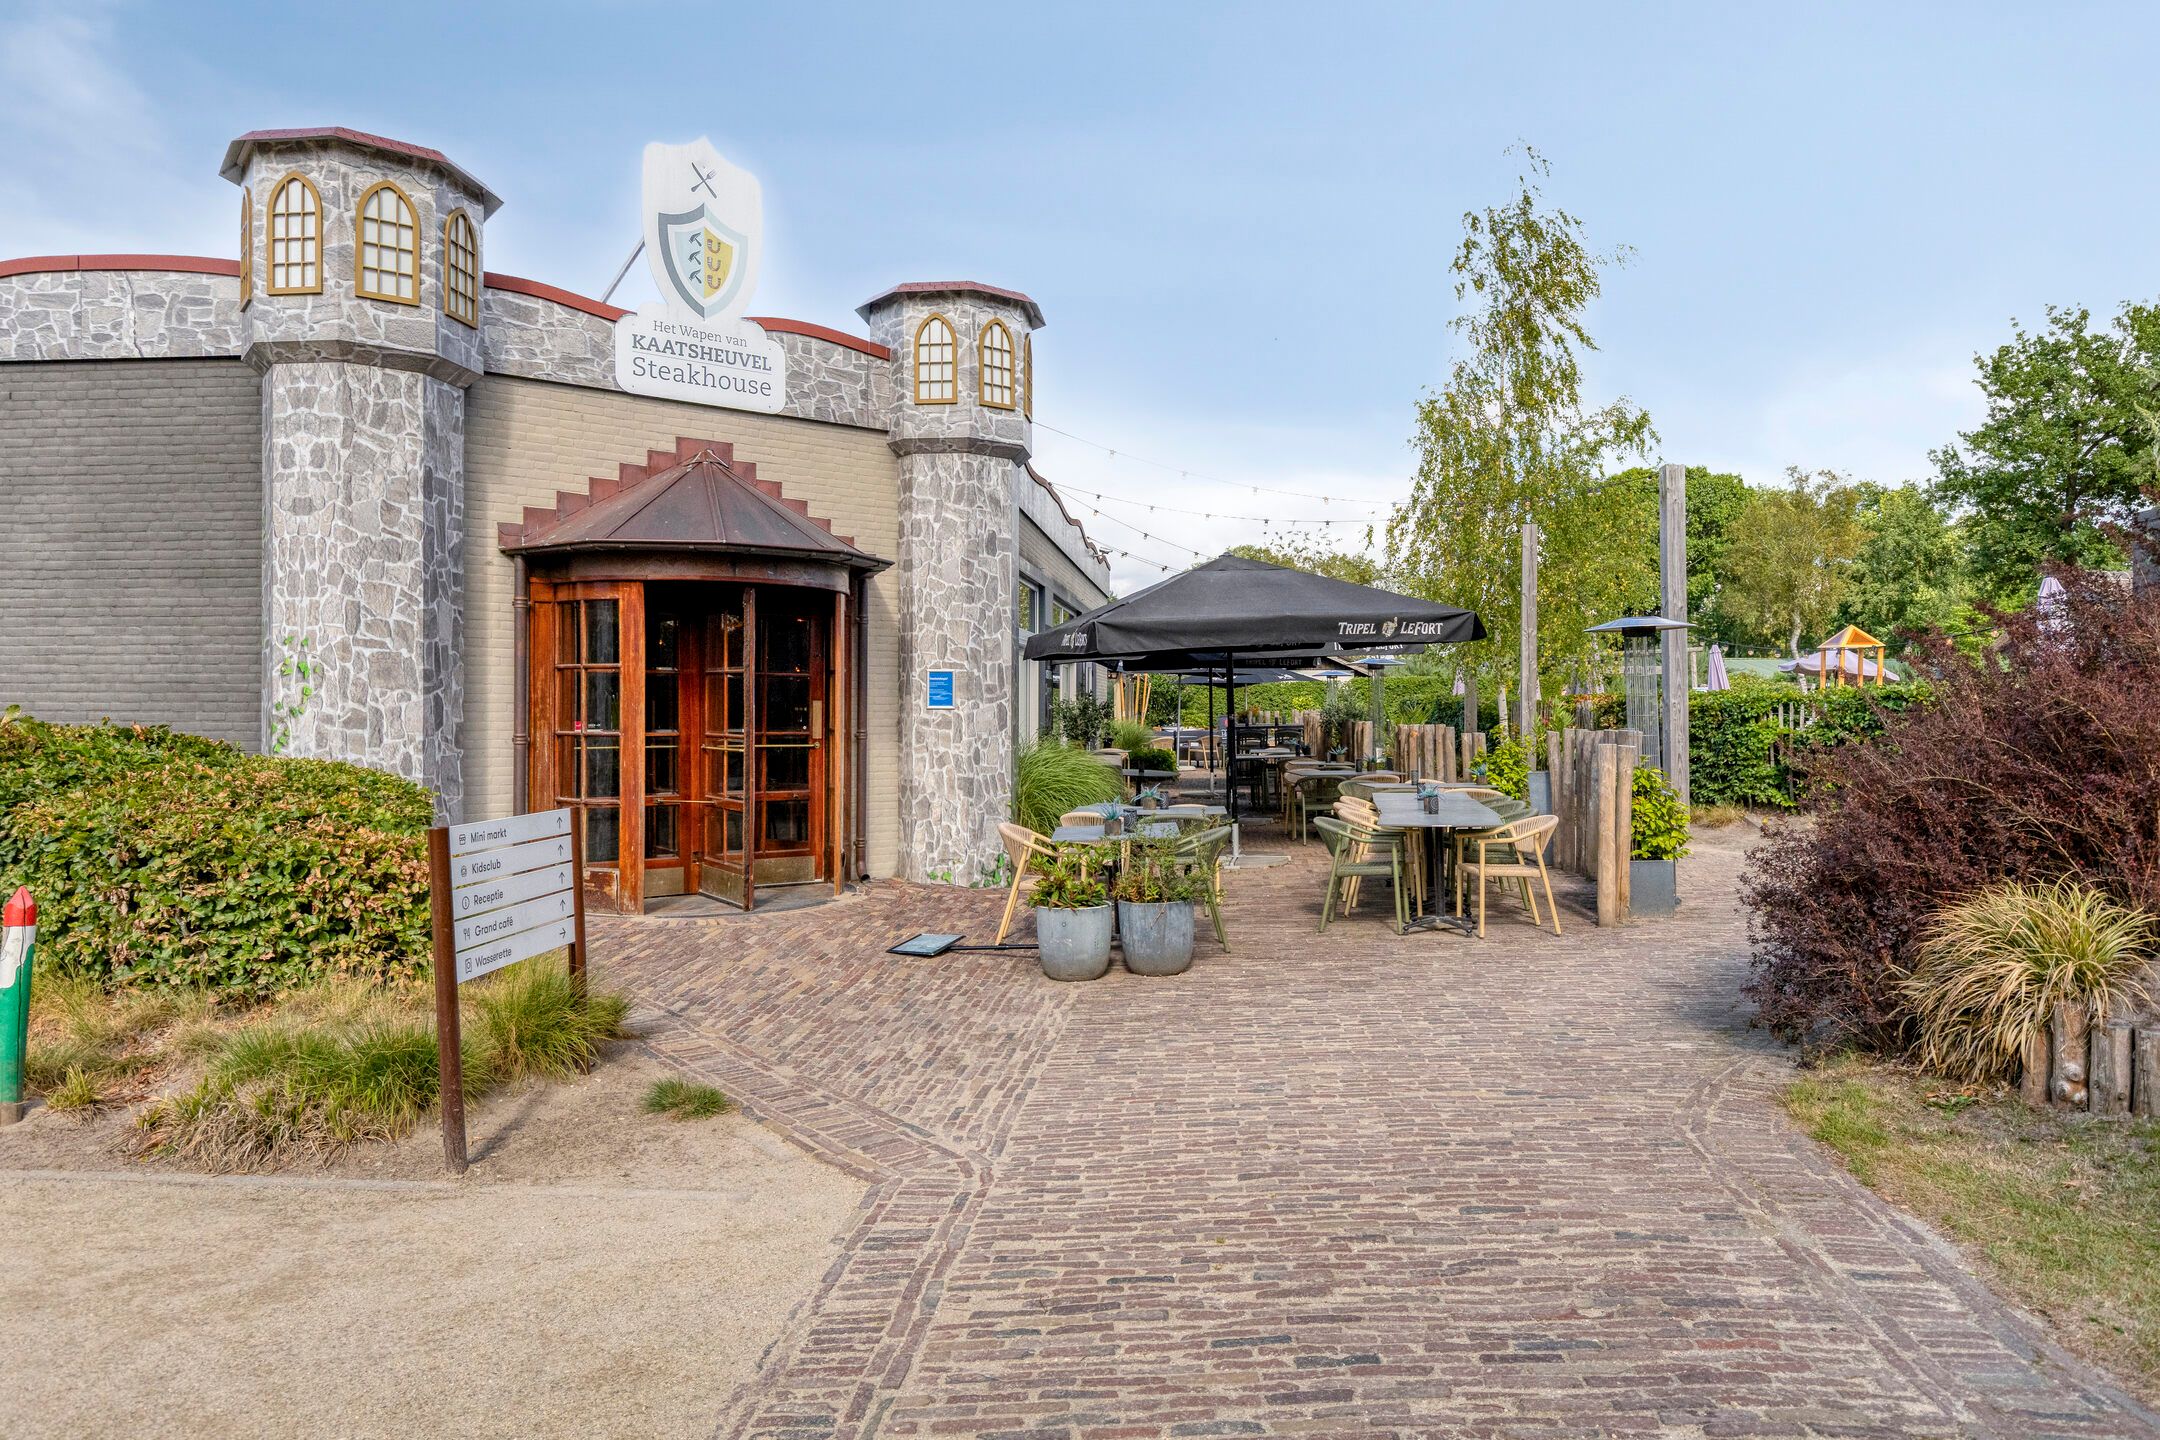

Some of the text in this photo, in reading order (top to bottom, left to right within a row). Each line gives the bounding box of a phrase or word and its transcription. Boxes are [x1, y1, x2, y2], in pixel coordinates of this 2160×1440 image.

[653, 320, 747, 348] Het Wapen van
[631, 333, 772, 372] KAATSHEUVEL
[632, 356, 772, 397] Steakhouse
[1338, 622, 1377, 635] TRIPEL
[470, 829, 508, 844] Mini markt
[471, 859, 502, 875] Kidsclub
[473, 890, 504, 906] Receptie
[474, 916, 514, 937] Grand café
[474, 948, 512, 968] Wasserette
